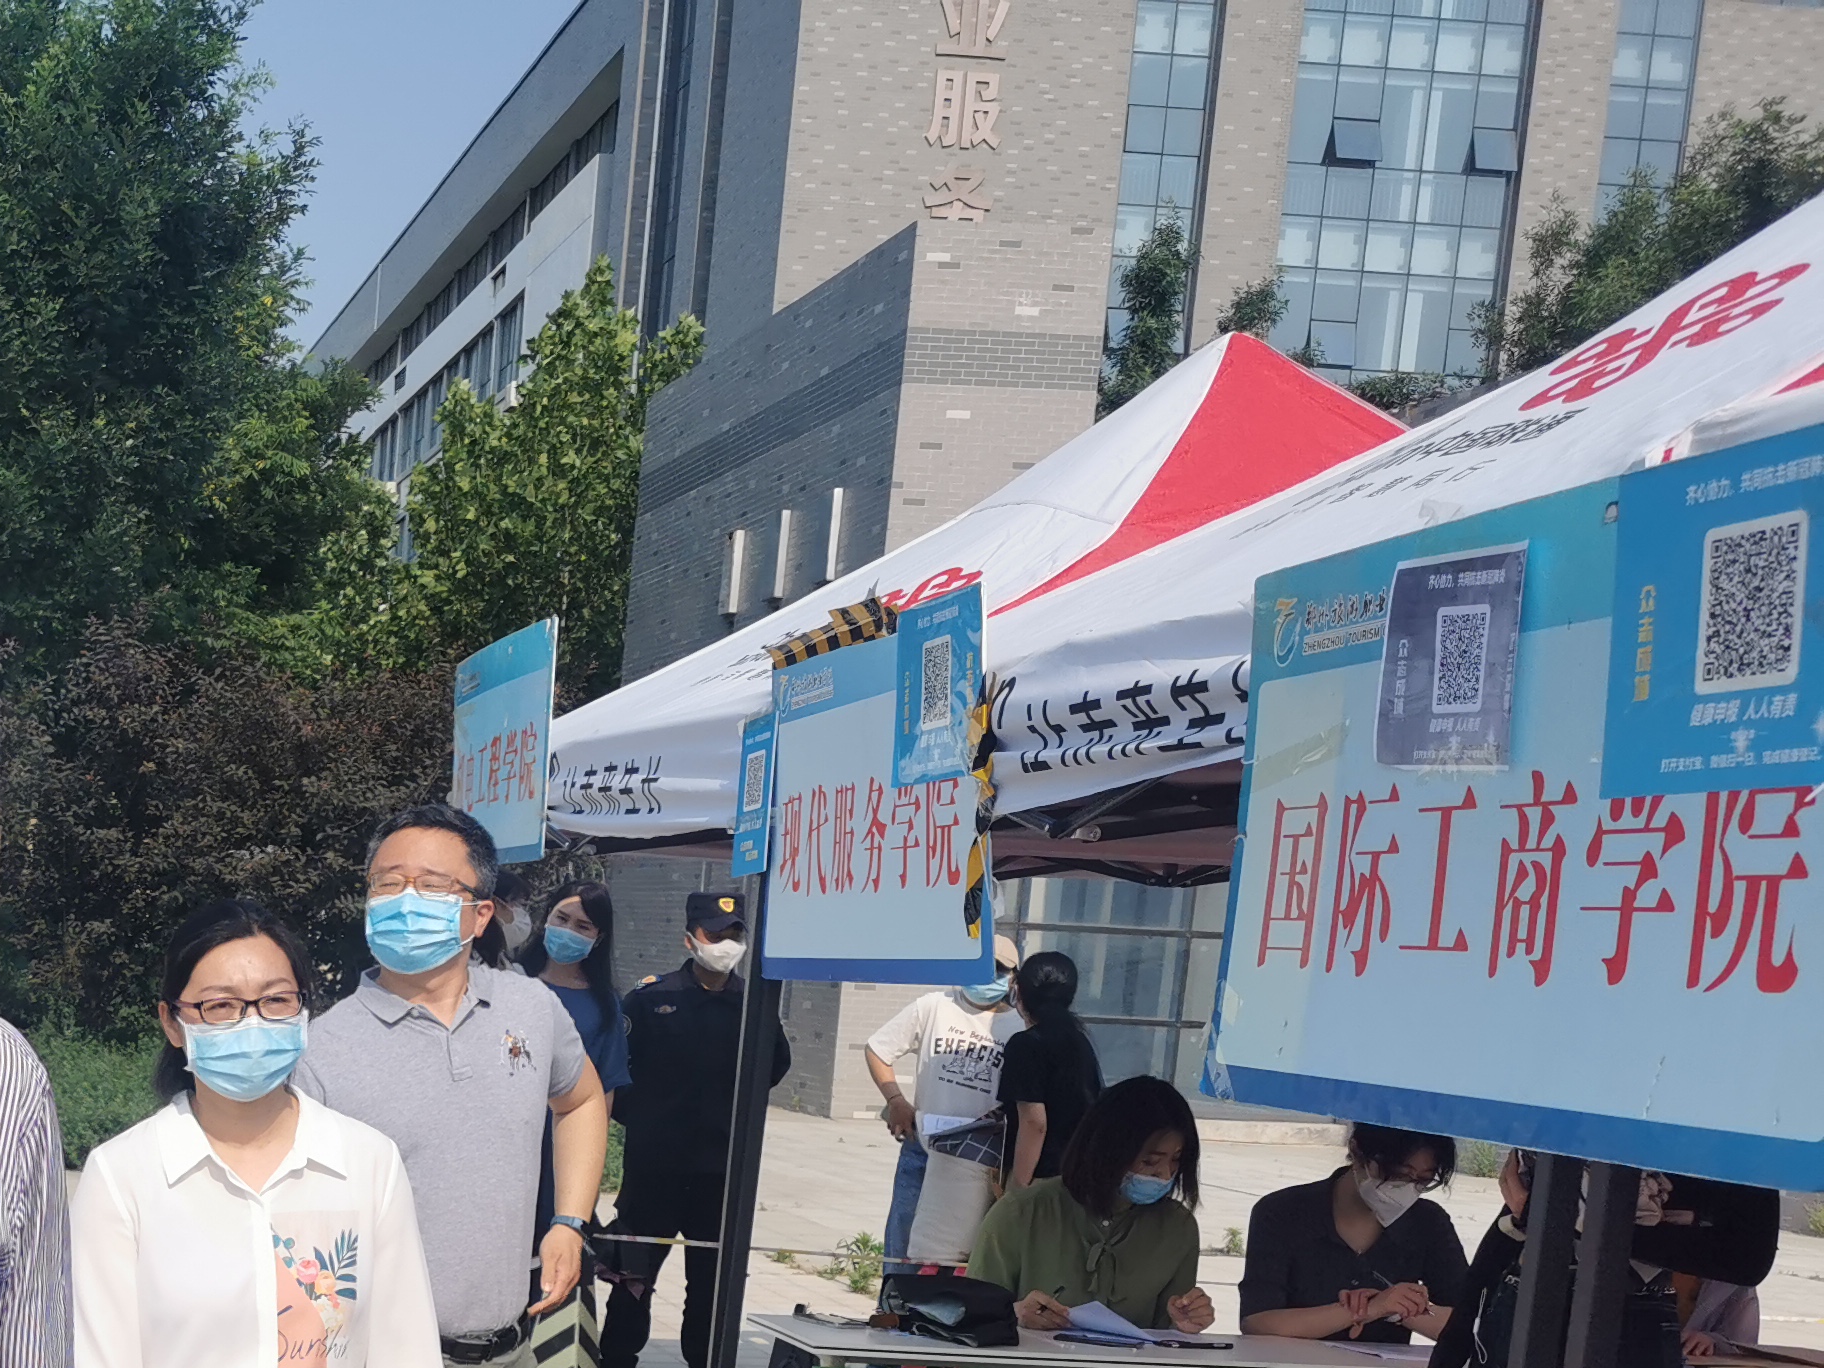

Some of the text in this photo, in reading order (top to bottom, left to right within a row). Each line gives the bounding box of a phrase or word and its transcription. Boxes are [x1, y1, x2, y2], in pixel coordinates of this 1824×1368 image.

[779, 776, 962, 897] 现代服务学院
[1256, 769, 1817, 995] 国际工商学院
